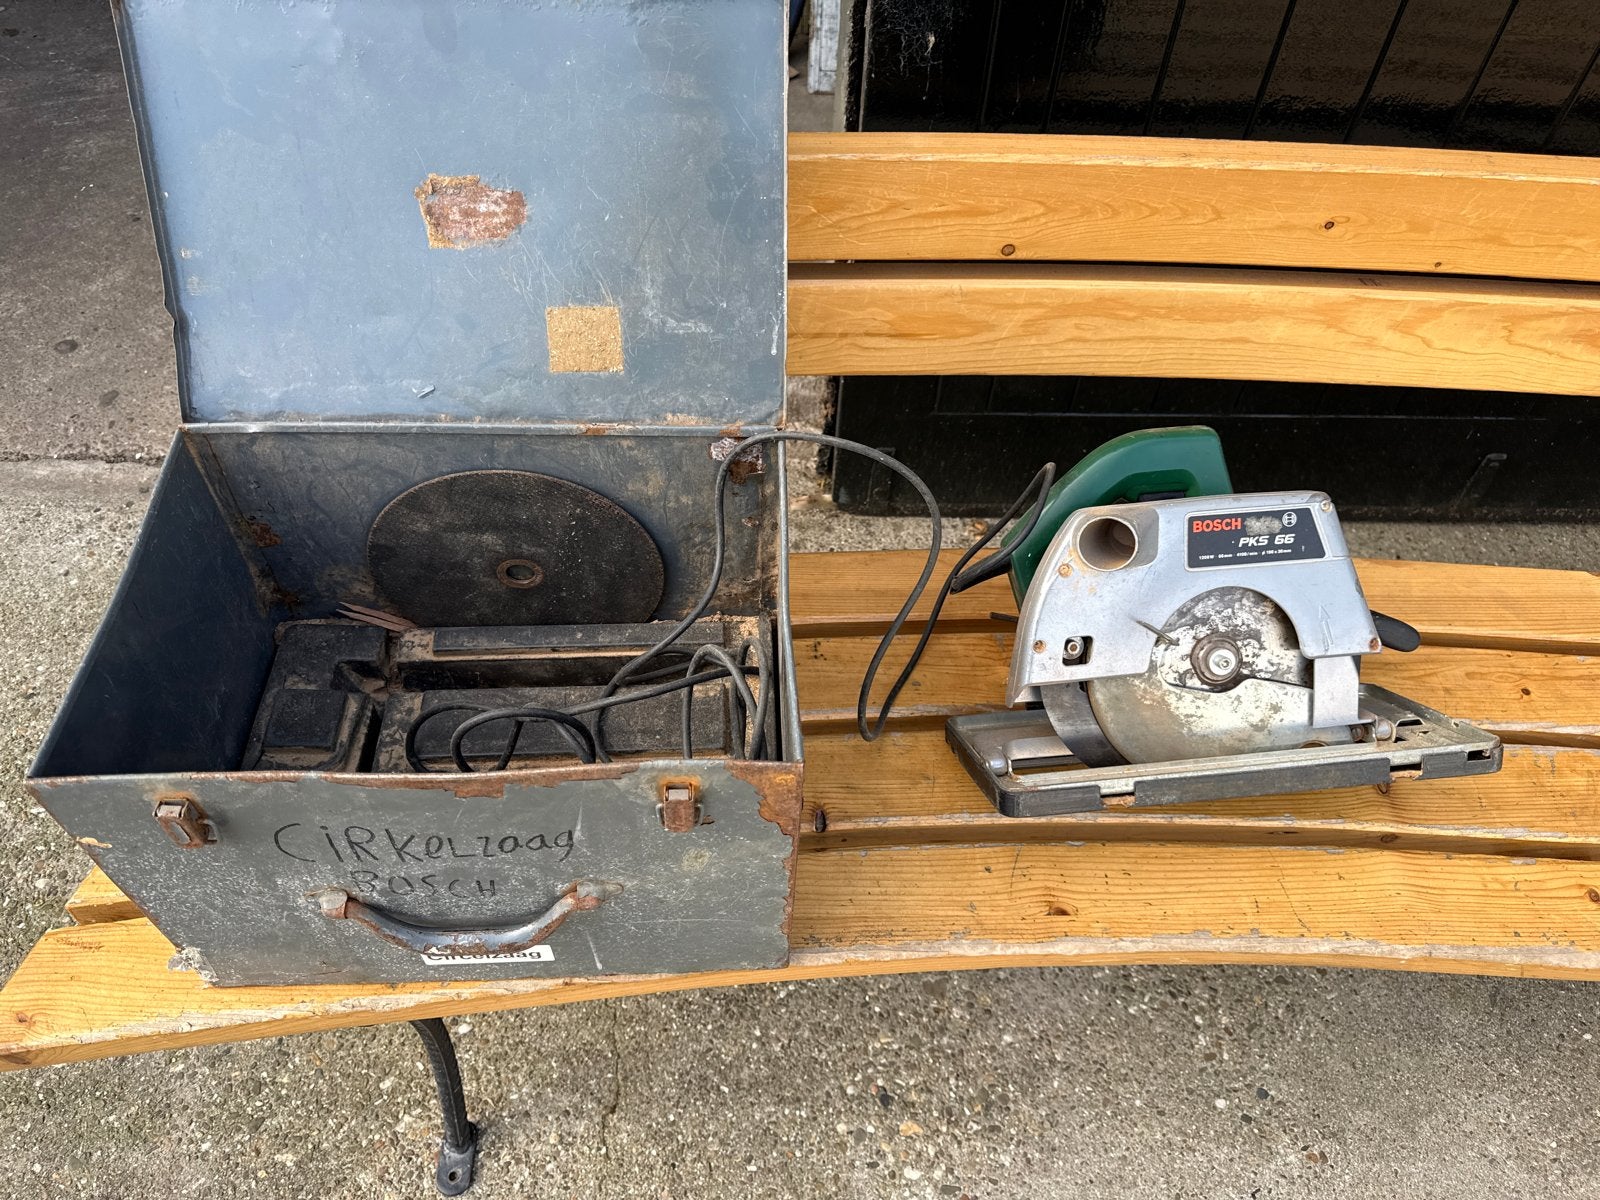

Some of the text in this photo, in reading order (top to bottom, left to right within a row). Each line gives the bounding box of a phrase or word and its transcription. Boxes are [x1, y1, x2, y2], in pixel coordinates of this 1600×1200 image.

[1192, 517, 1242, 533] BOSCH
[1238, 533, 1296, 548] PKS 66
[351, 870, 498, 897] BOSCH
